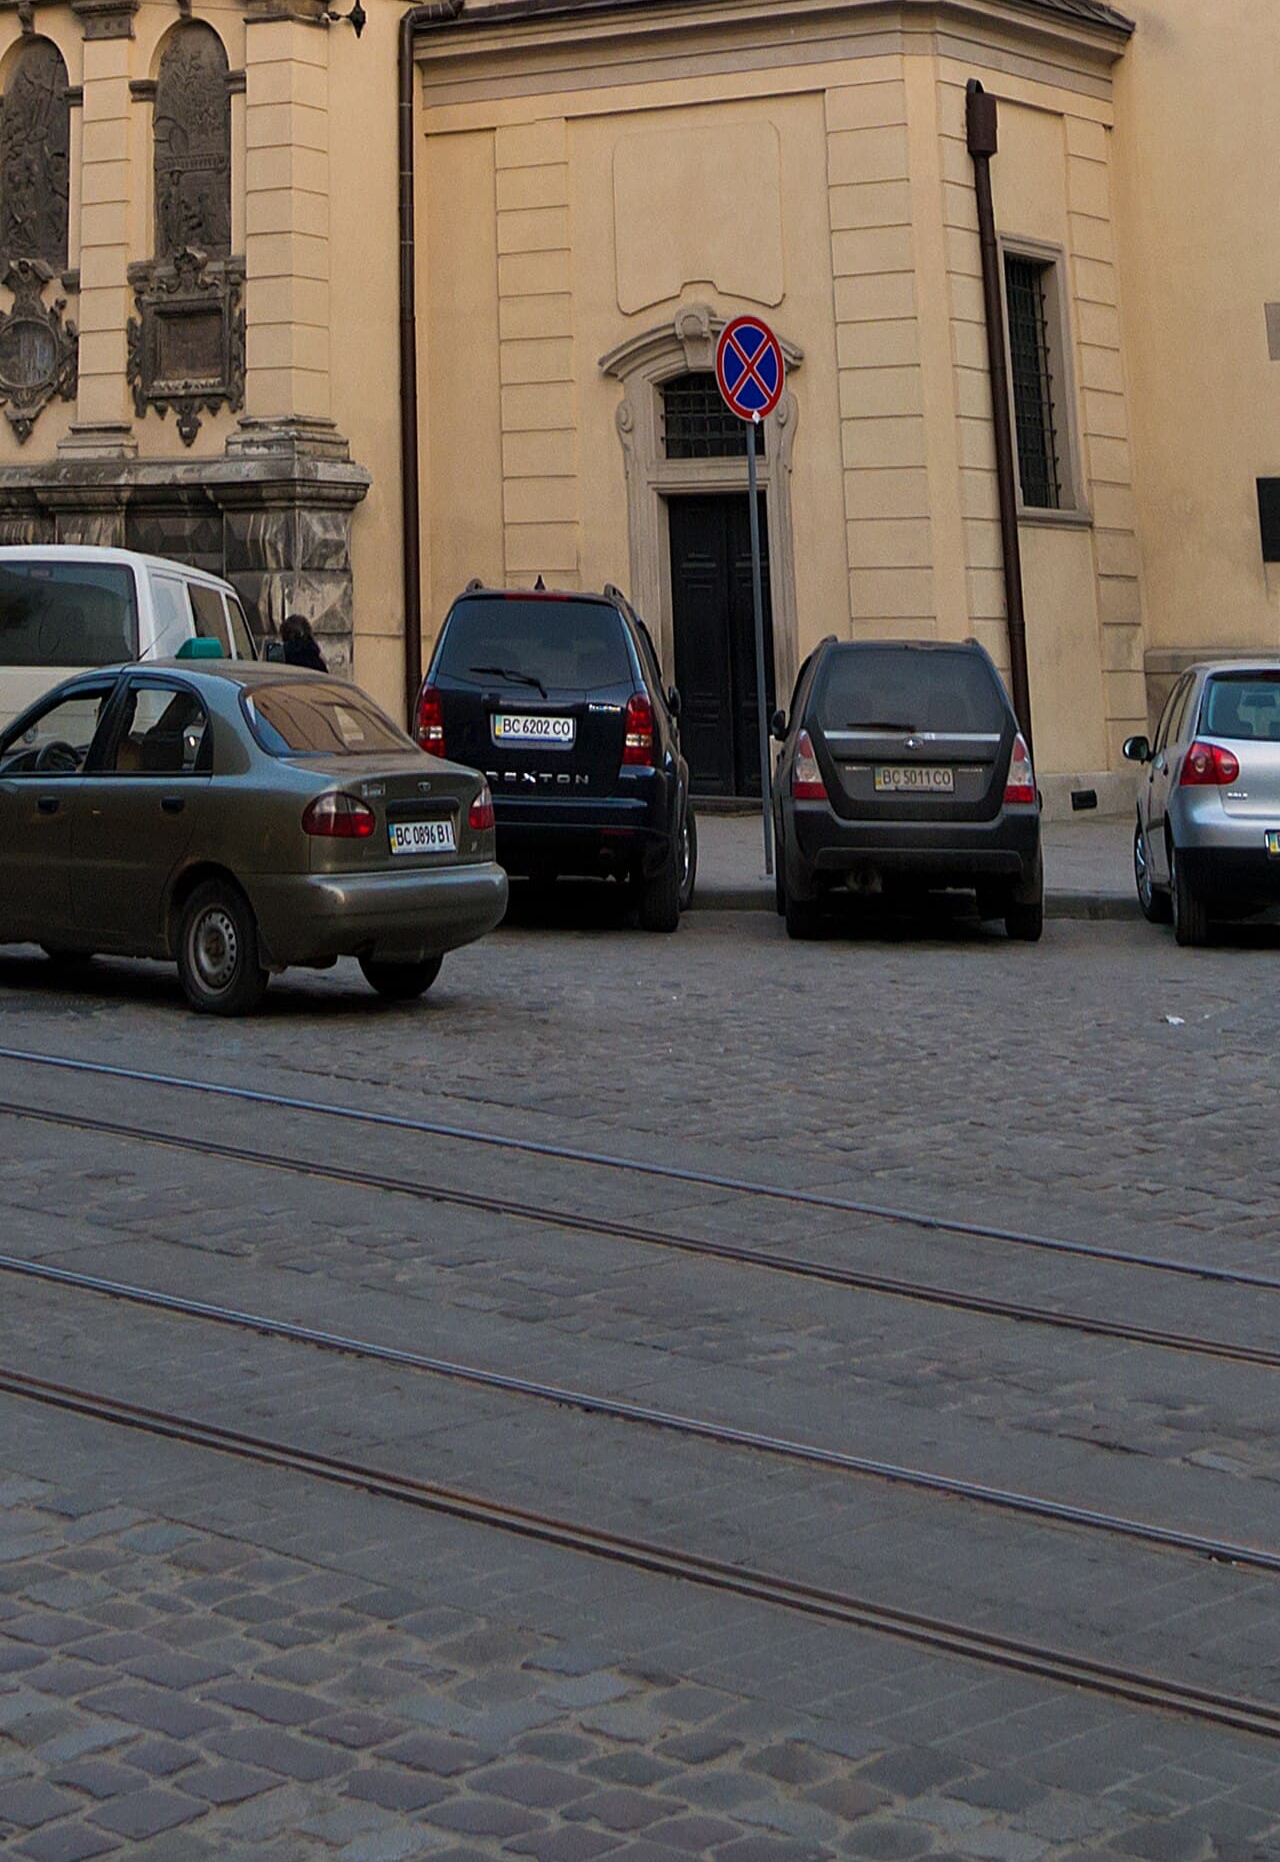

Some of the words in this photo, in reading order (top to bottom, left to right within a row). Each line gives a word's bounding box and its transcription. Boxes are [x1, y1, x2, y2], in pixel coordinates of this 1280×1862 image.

[503, 718, 520, 733] BC
[522, 719, 550, 735] 6202
[552, 720, 570, 736] CO
[882, 769, 901, 784] BC
[904, 770, 931, 785] 5011
[933, 771, 951, 785] CO
[395, 826, 412, 846] BC
[413, 825, 436, 845] 0896
[437, 824, 450, 843] BI
